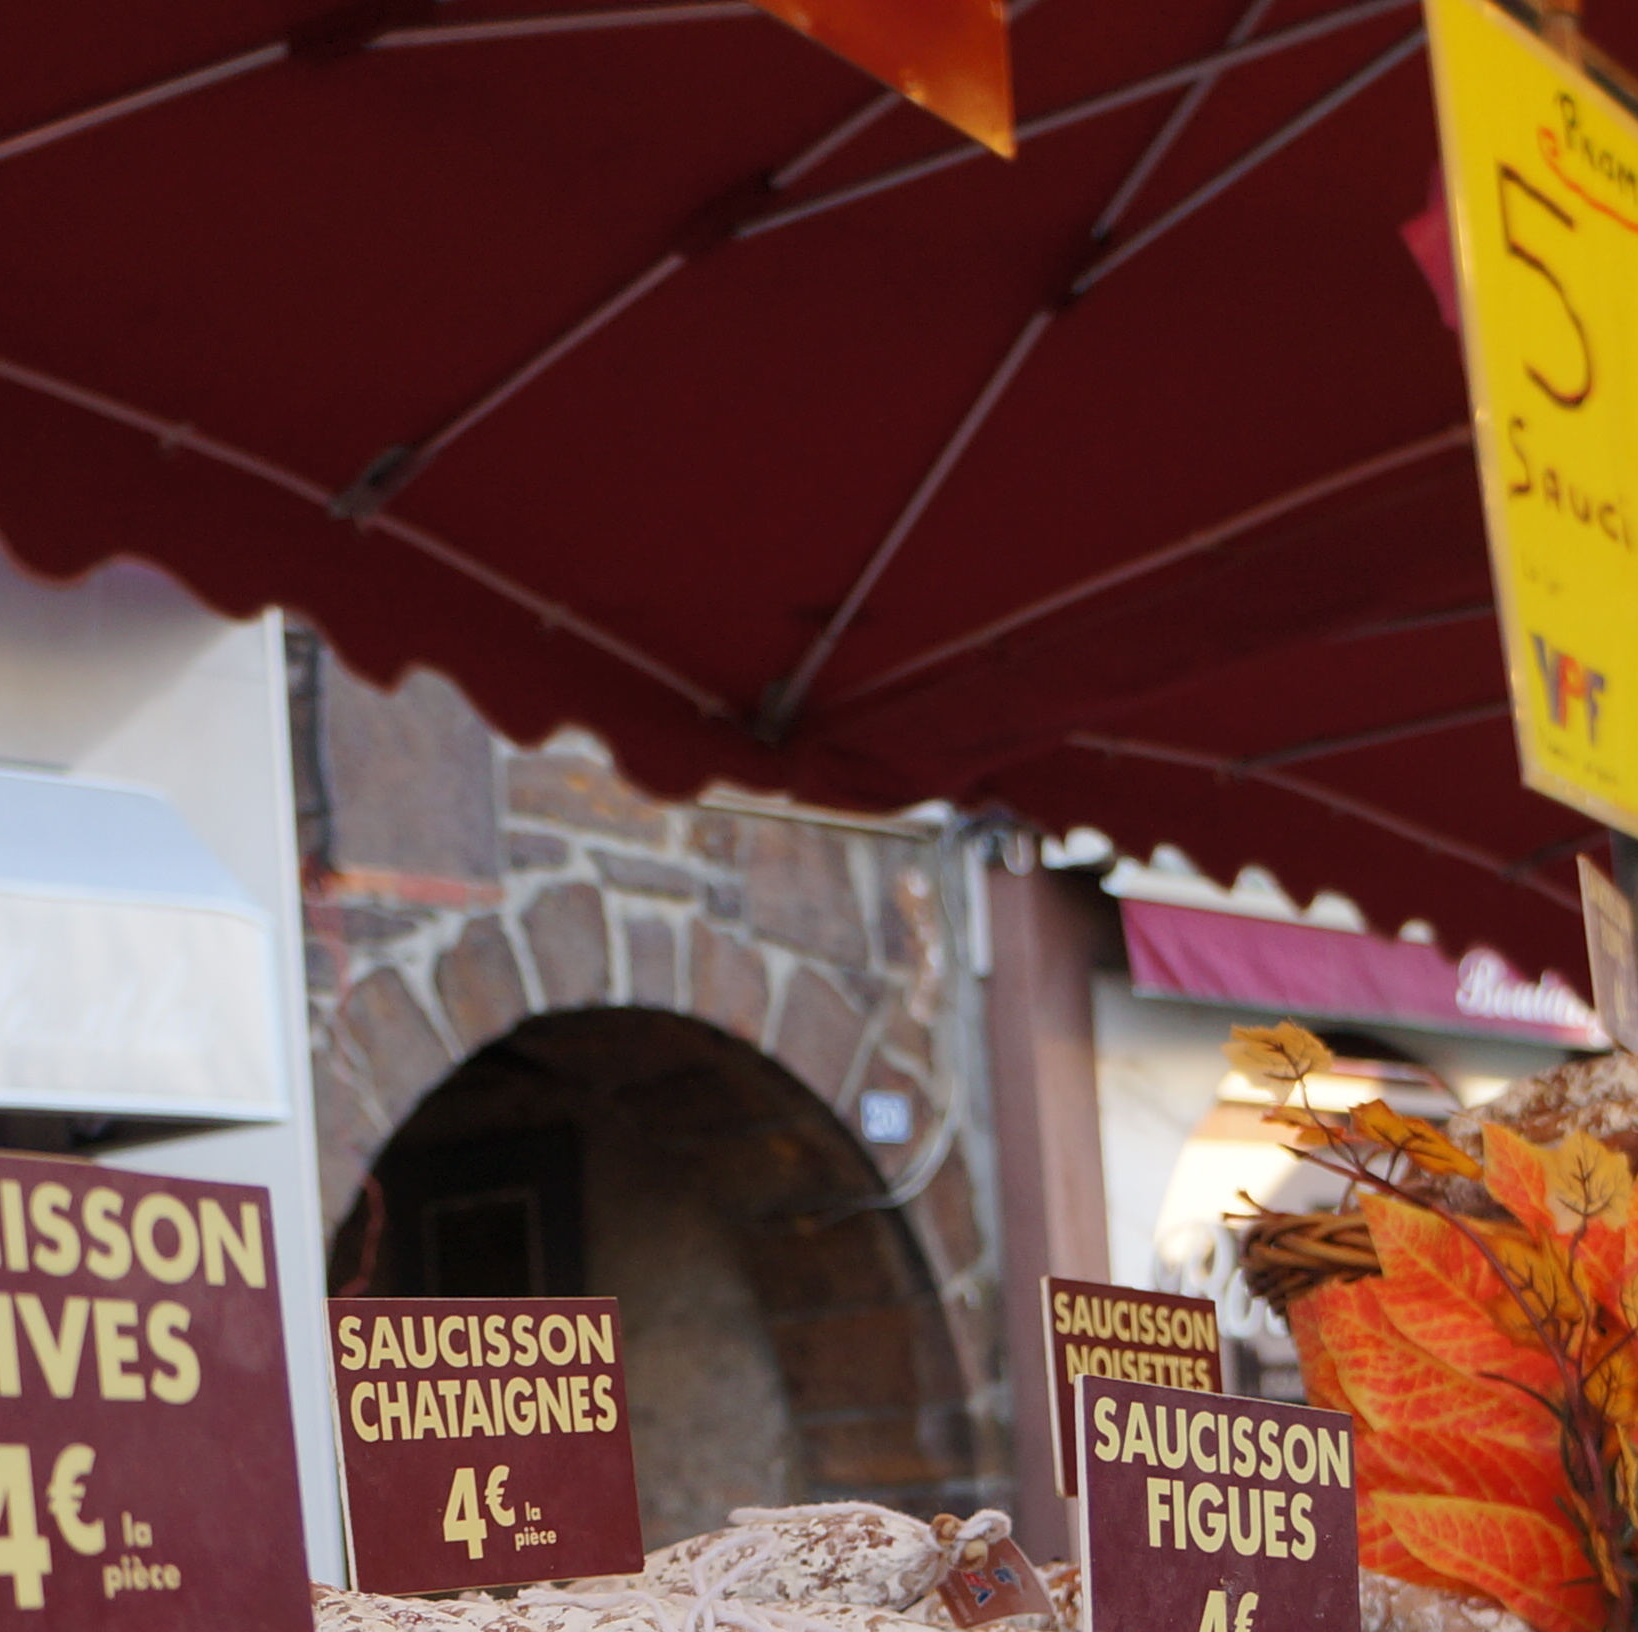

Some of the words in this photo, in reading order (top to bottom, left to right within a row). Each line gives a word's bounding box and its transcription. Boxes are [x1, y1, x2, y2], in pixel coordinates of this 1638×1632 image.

[1495, 160, 1594, 411] 5
[338, 1313, 616, 1370] SAUCISSON
[1052, 1291, 1217, 1353] SAUCISSON
[1065, 1343, 1213, 1394] NOISETTES
[350, 1374, 619, 1443] CHATAIGNES
[1093, 1396, 1351, 1489] SAUCISSON
[122, 1511, 153, 1548] la
[514, 1527, 557, 1552] pièce
[524, 1501, 542, 1522] la
[1146, 1477, 1317, 1561] FIGUES
[102, 1554, 182, 1600] pièce
